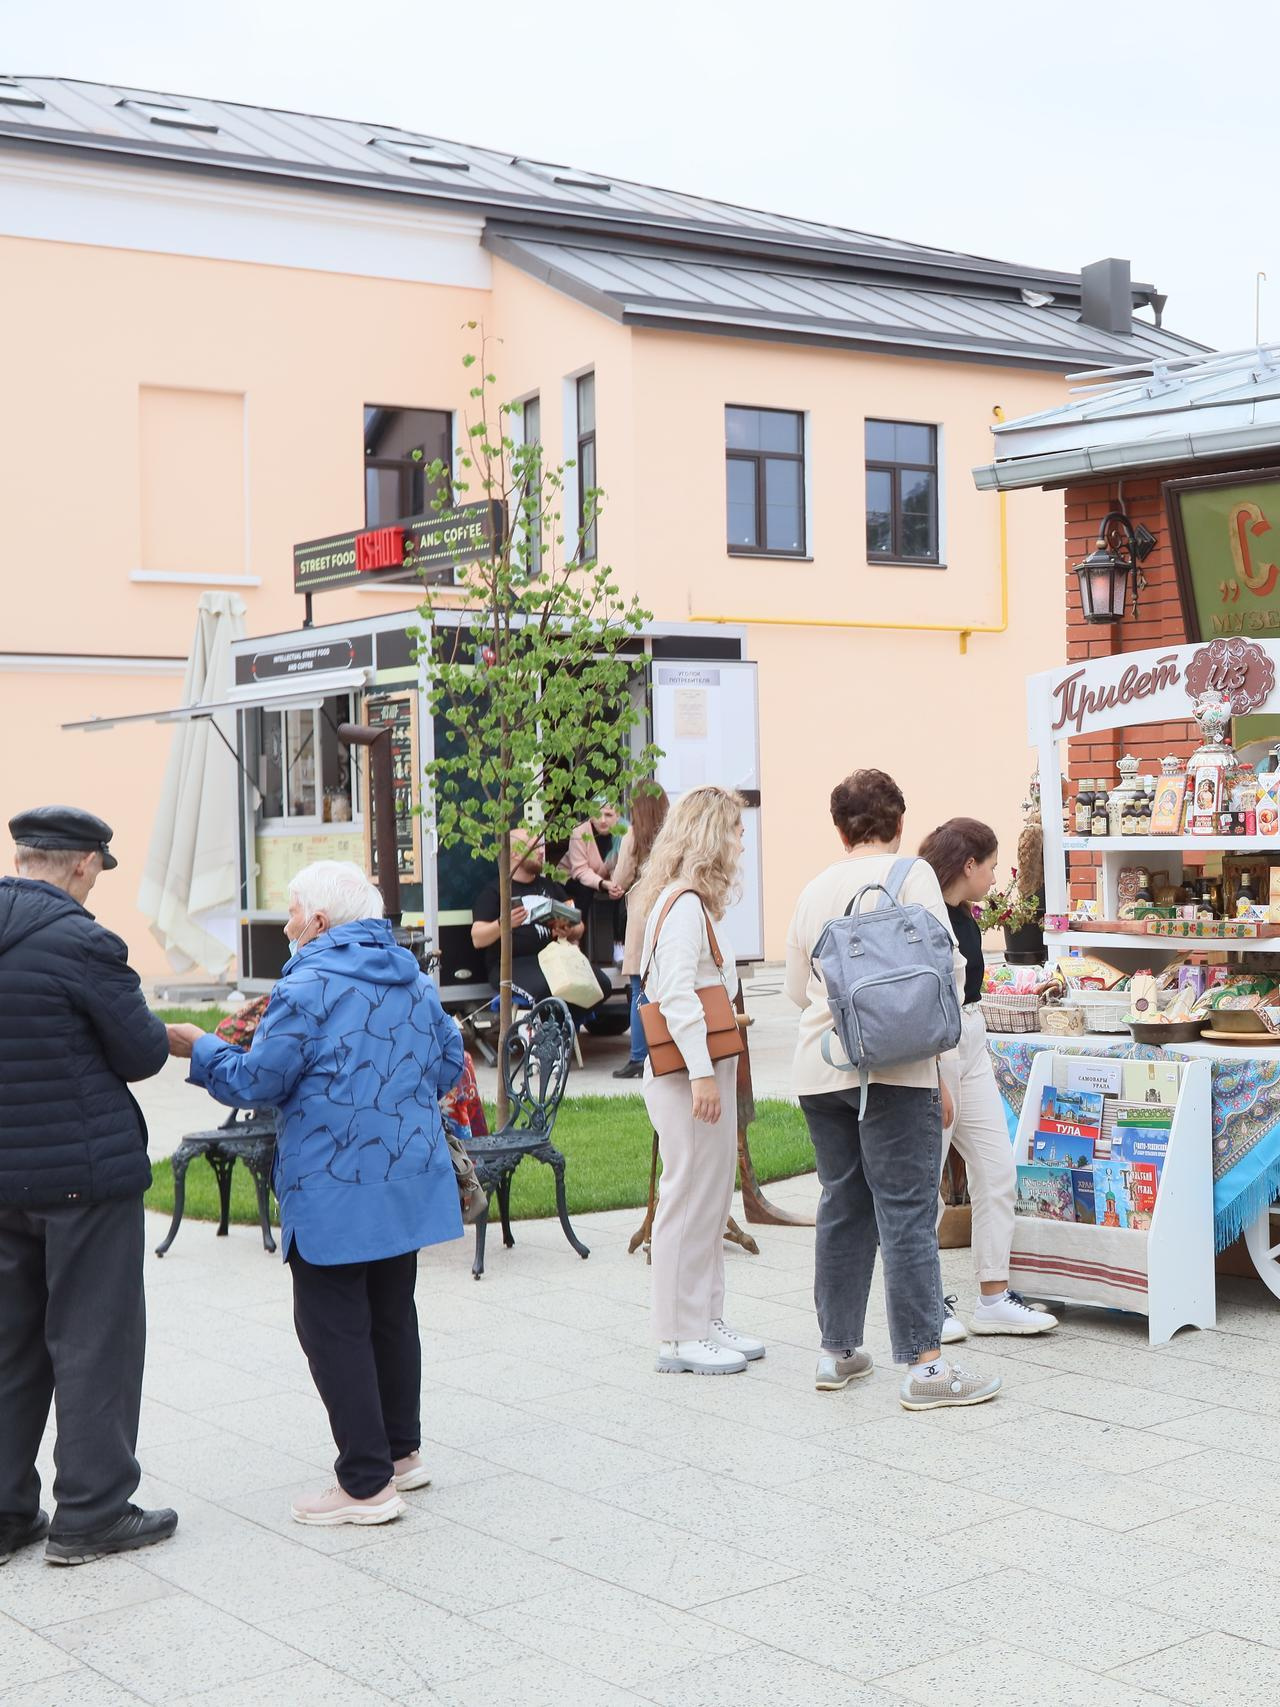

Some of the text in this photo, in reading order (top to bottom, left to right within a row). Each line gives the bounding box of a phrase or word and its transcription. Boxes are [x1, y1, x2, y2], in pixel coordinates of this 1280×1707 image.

[300, 556, 330, 574] STREET
[331, 551, 356, 567] FOOD
[1052, 654, 1181, 732] Привет
[1205, 663, 1248, 691] из
[1078, 1075, 1108, 1083] САМОВАРЫ
[1055, 1123, 1081, 1137] ТУЛА
